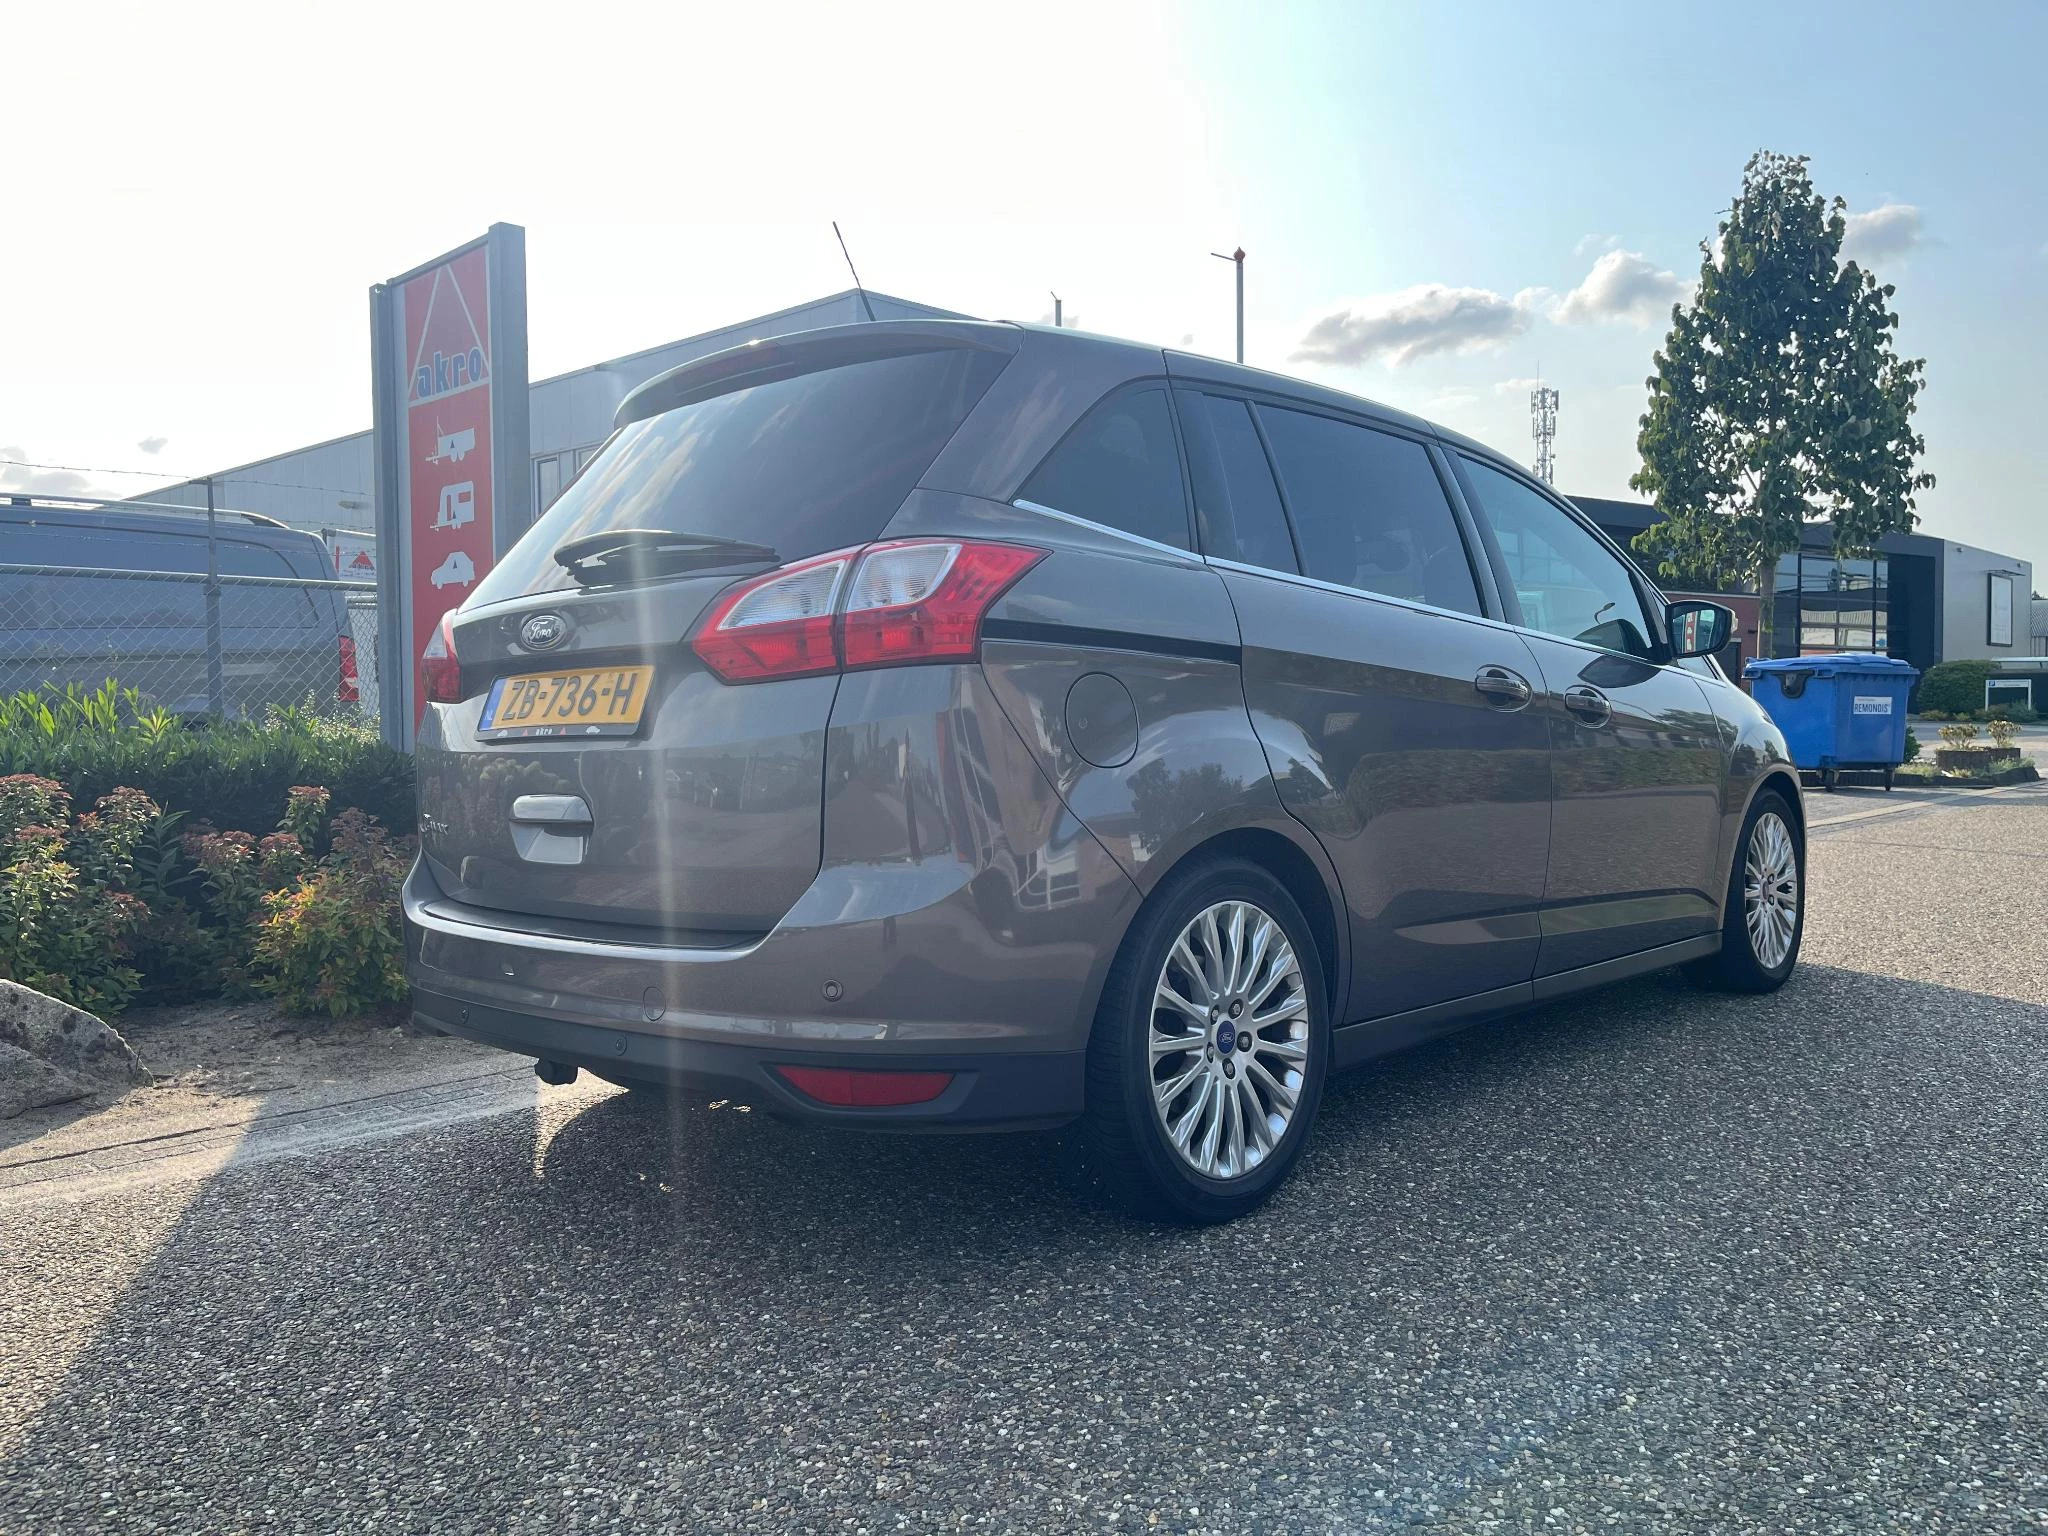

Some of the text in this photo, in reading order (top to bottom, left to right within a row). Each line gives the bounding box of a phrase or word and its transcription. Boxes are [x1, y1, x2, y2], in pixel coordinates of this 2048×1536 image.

[416, 347, 483, 399] akro
[528, 620, 553, 639] Ford
[502, 673, 638, 721] ZB-736-H
[1855, 703, 1888, 713] REMONDIS
[535, 727, 553, 736] akro
